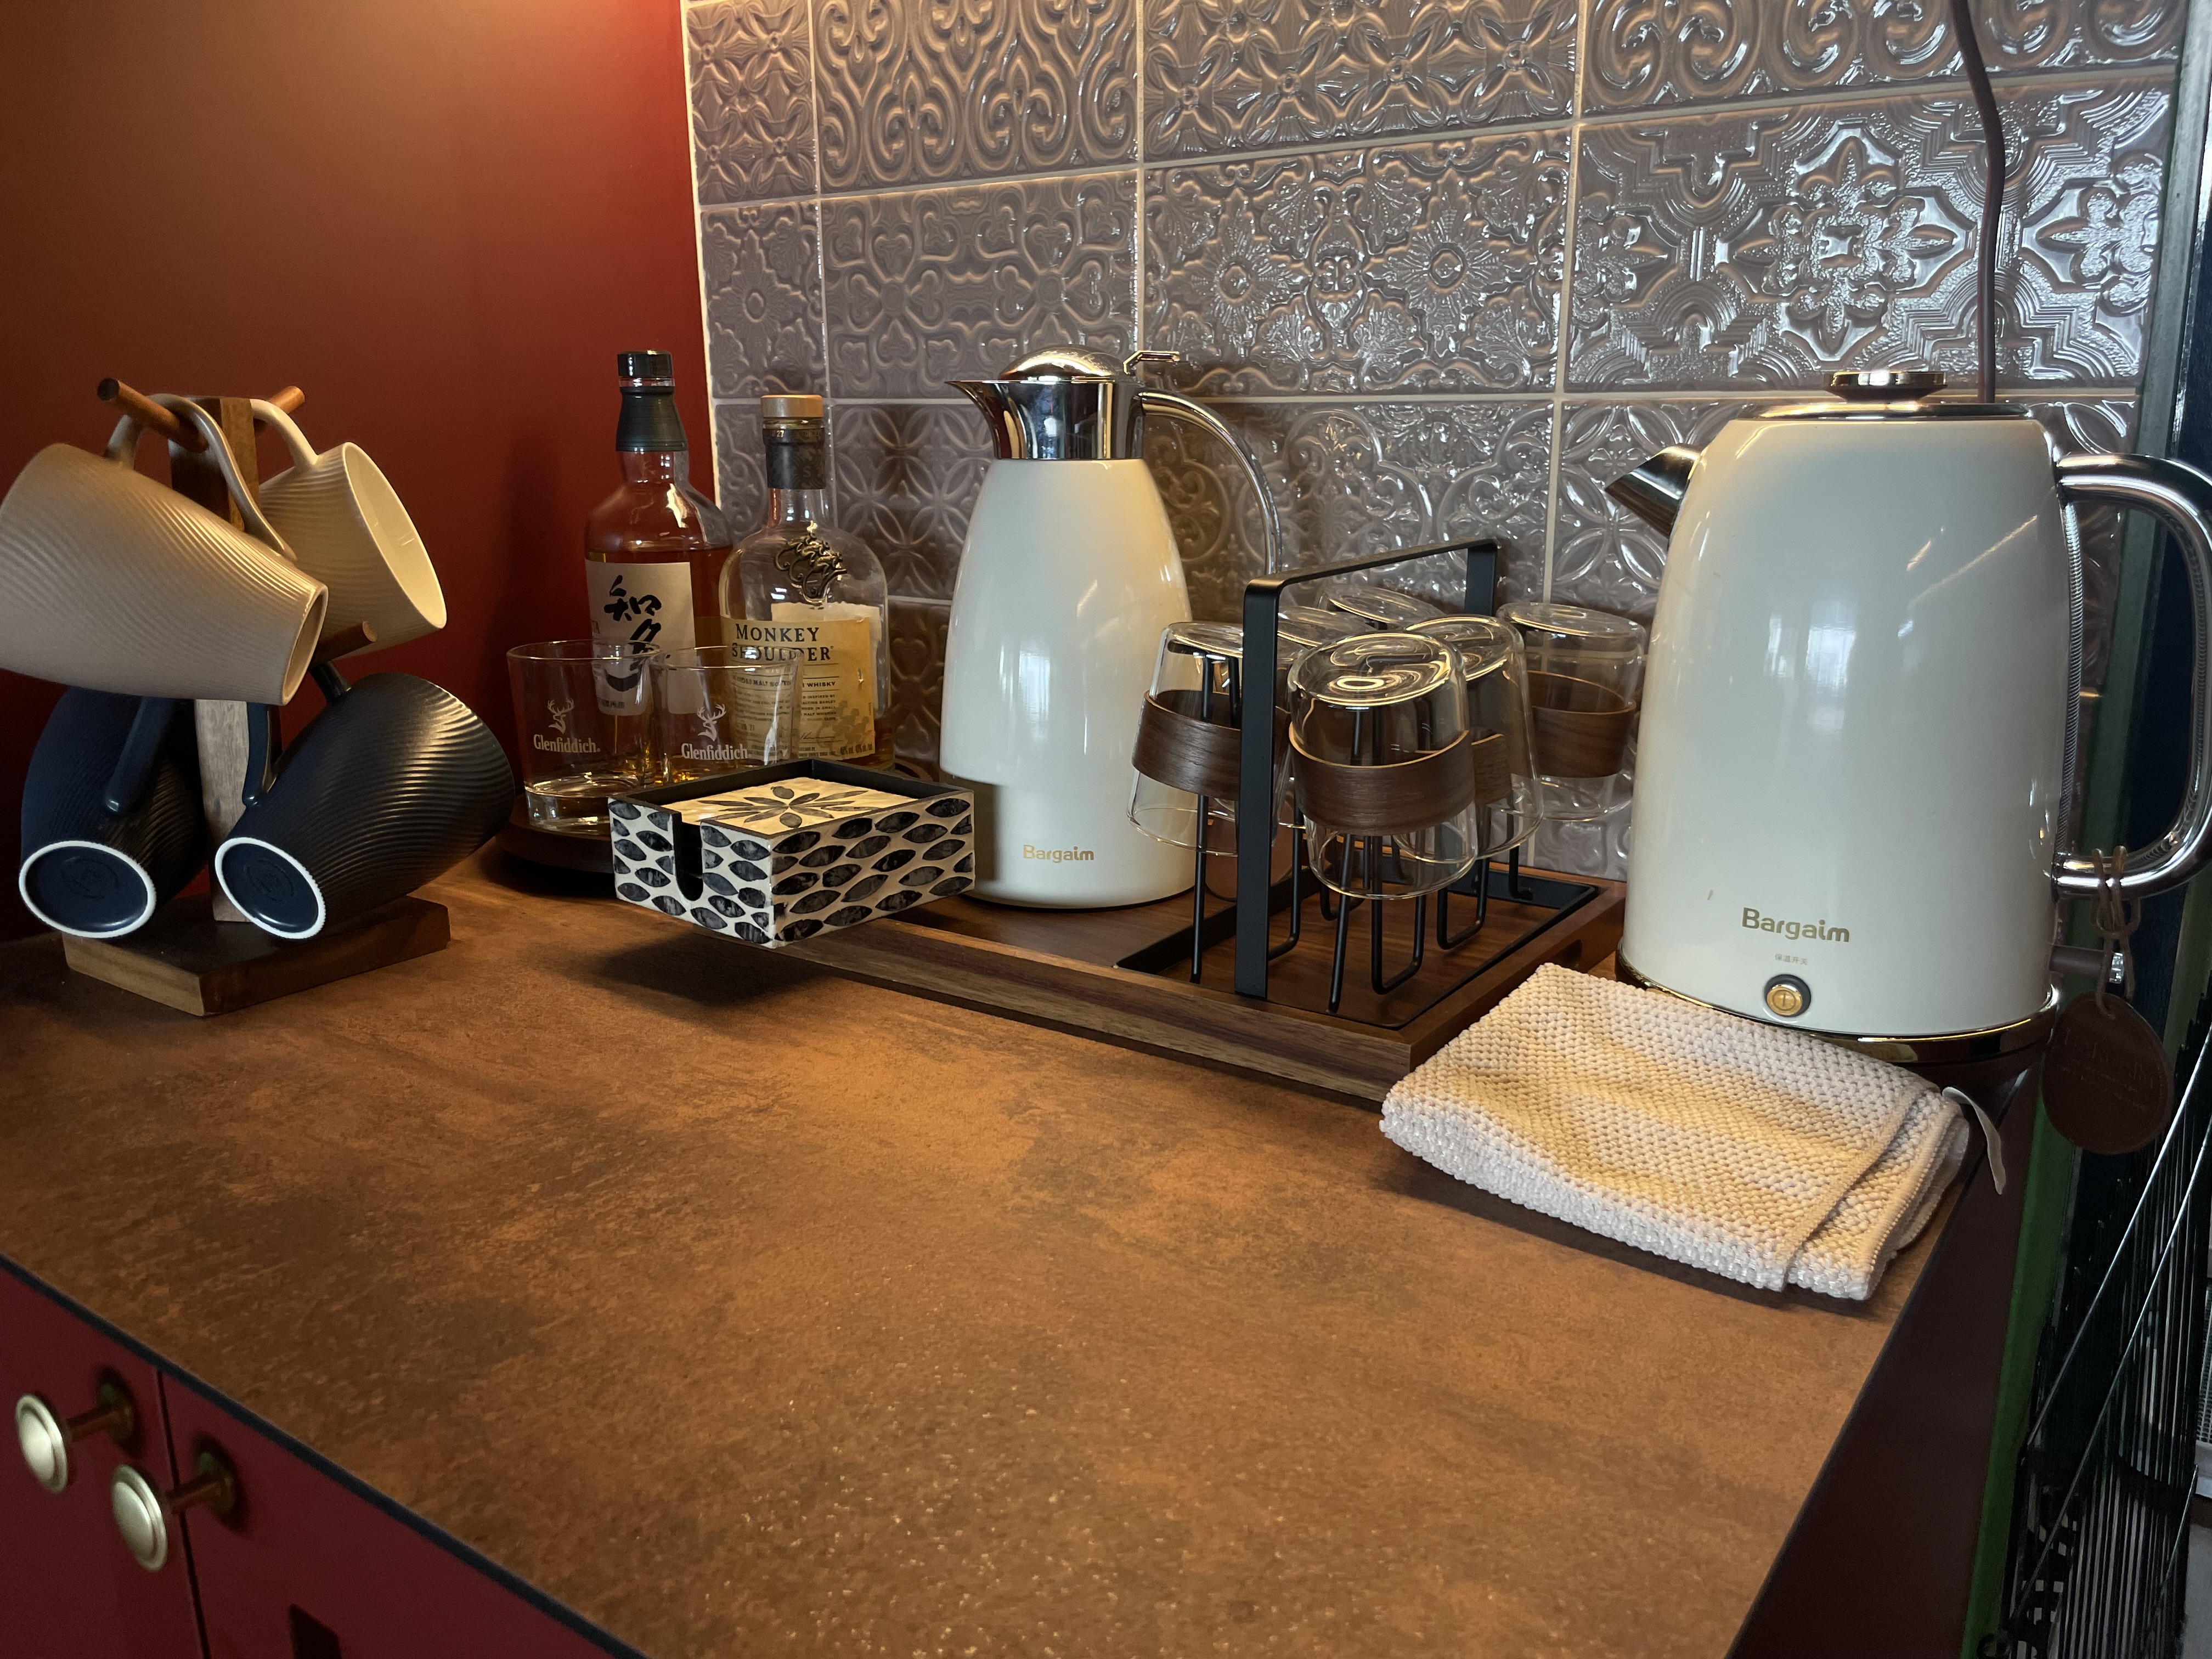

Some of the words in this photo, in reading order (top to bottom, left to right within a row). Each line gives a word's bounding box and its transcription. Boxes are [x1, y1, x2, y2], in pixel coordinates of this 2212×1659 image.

[736, 623, 820, 642] MONKEY
[533, 734, 597, 753] Glenfiddich
[681, 743, 748, 760] Glenfiddich
[1023, 844, 1094, 864] Bargaim
[1742, 907, 1850, 943] Bargaim
